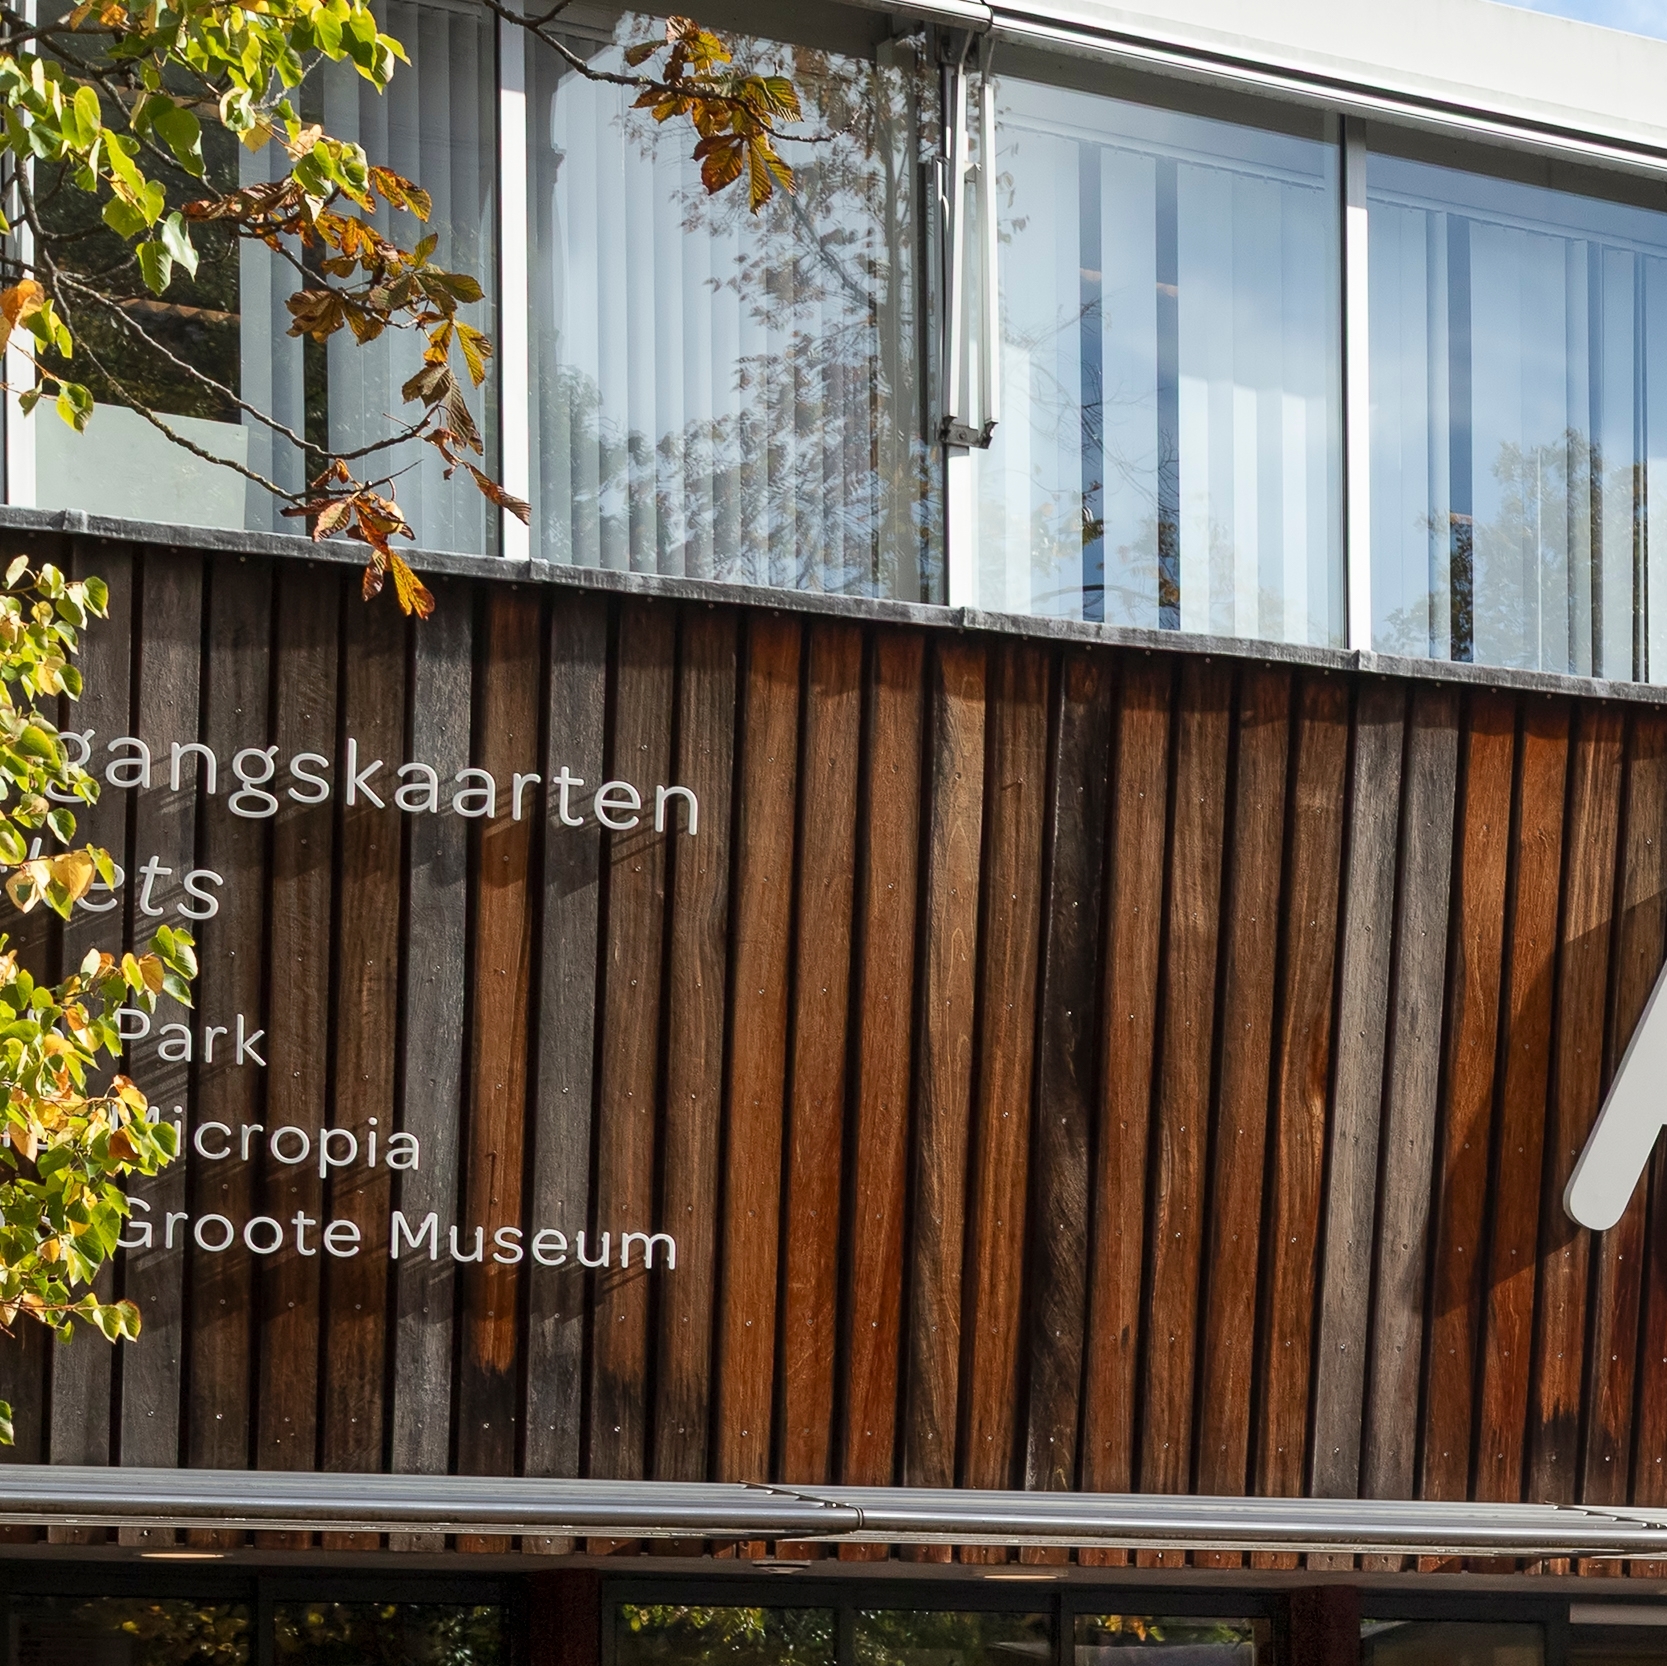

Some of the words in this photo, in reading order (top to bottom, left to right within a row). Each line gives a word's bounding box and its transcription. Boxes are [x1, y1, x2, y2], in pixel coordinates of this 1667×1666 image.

[115, 1007, 267, 1067] Park
[116, 1196, 361, 1259] Groote
[389, 1210, 678, 1271] Museum
